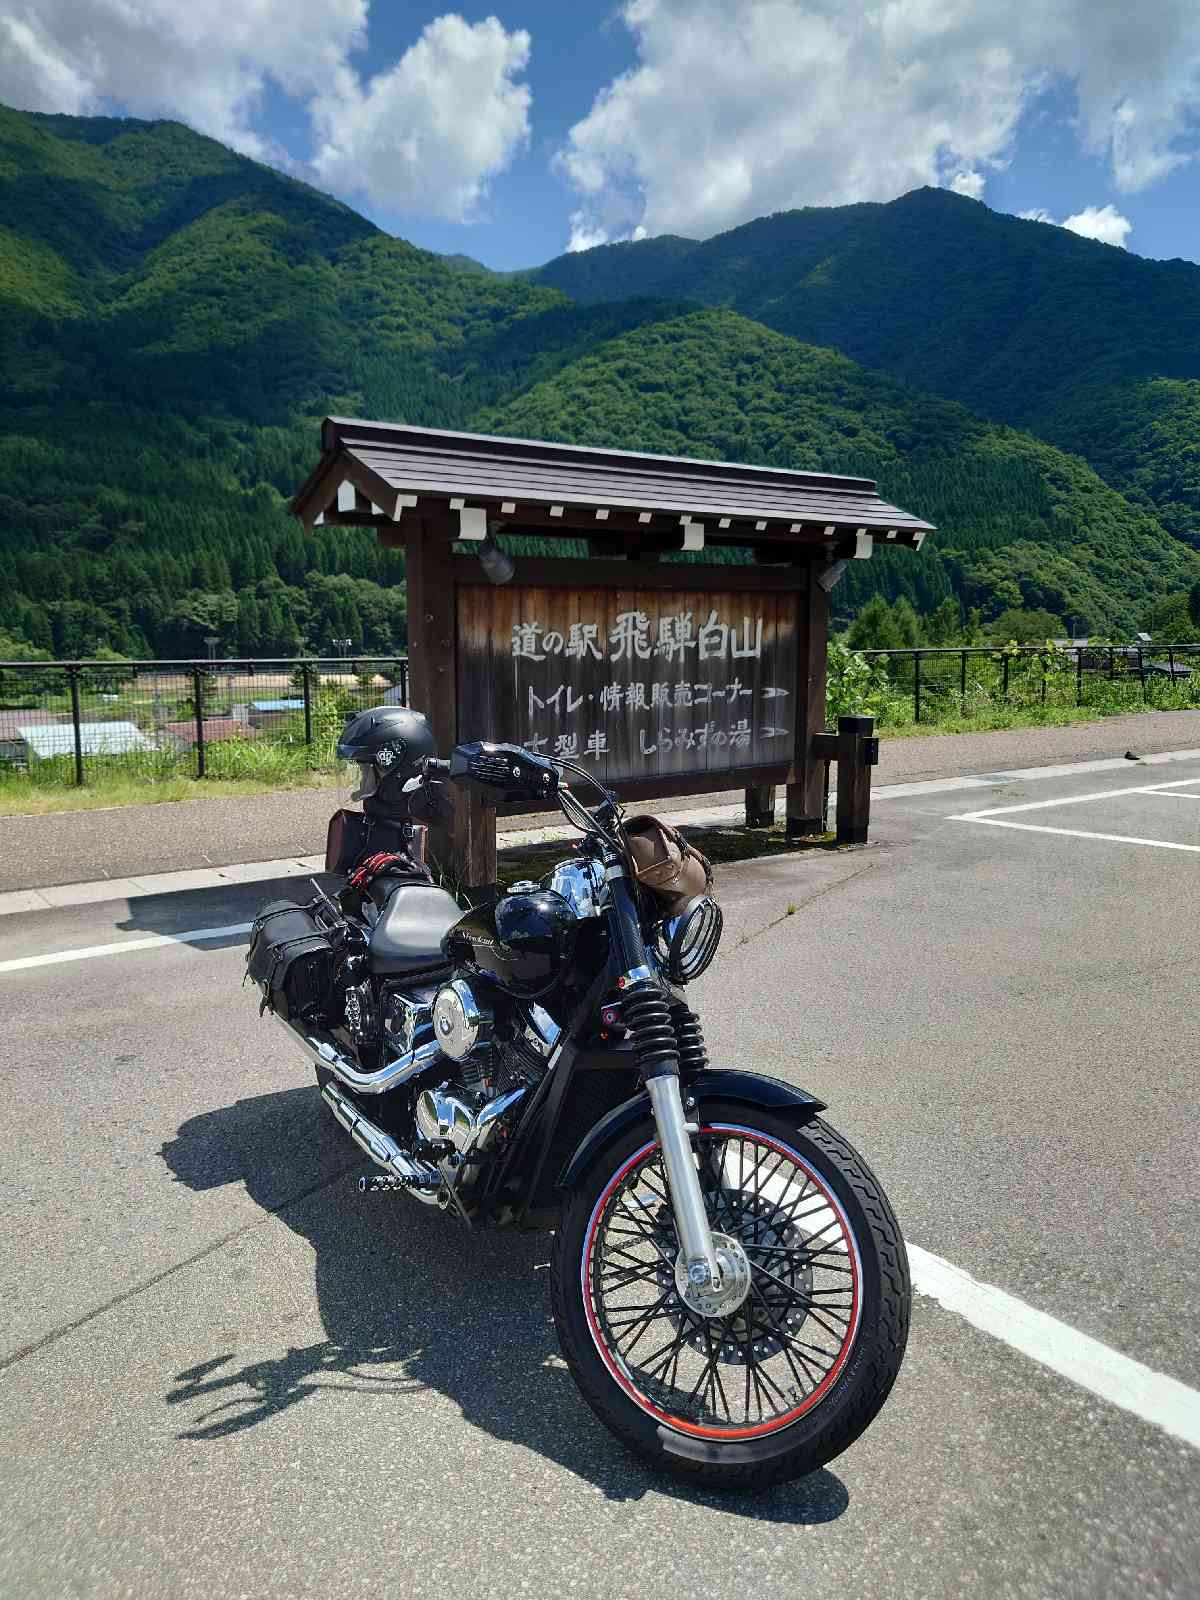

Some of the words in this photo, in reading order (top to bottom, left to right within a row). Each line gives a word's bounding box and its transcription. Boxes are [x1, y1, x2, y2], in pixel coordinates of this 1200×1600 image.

[639, 718, 752, 755] しらみずの湯
